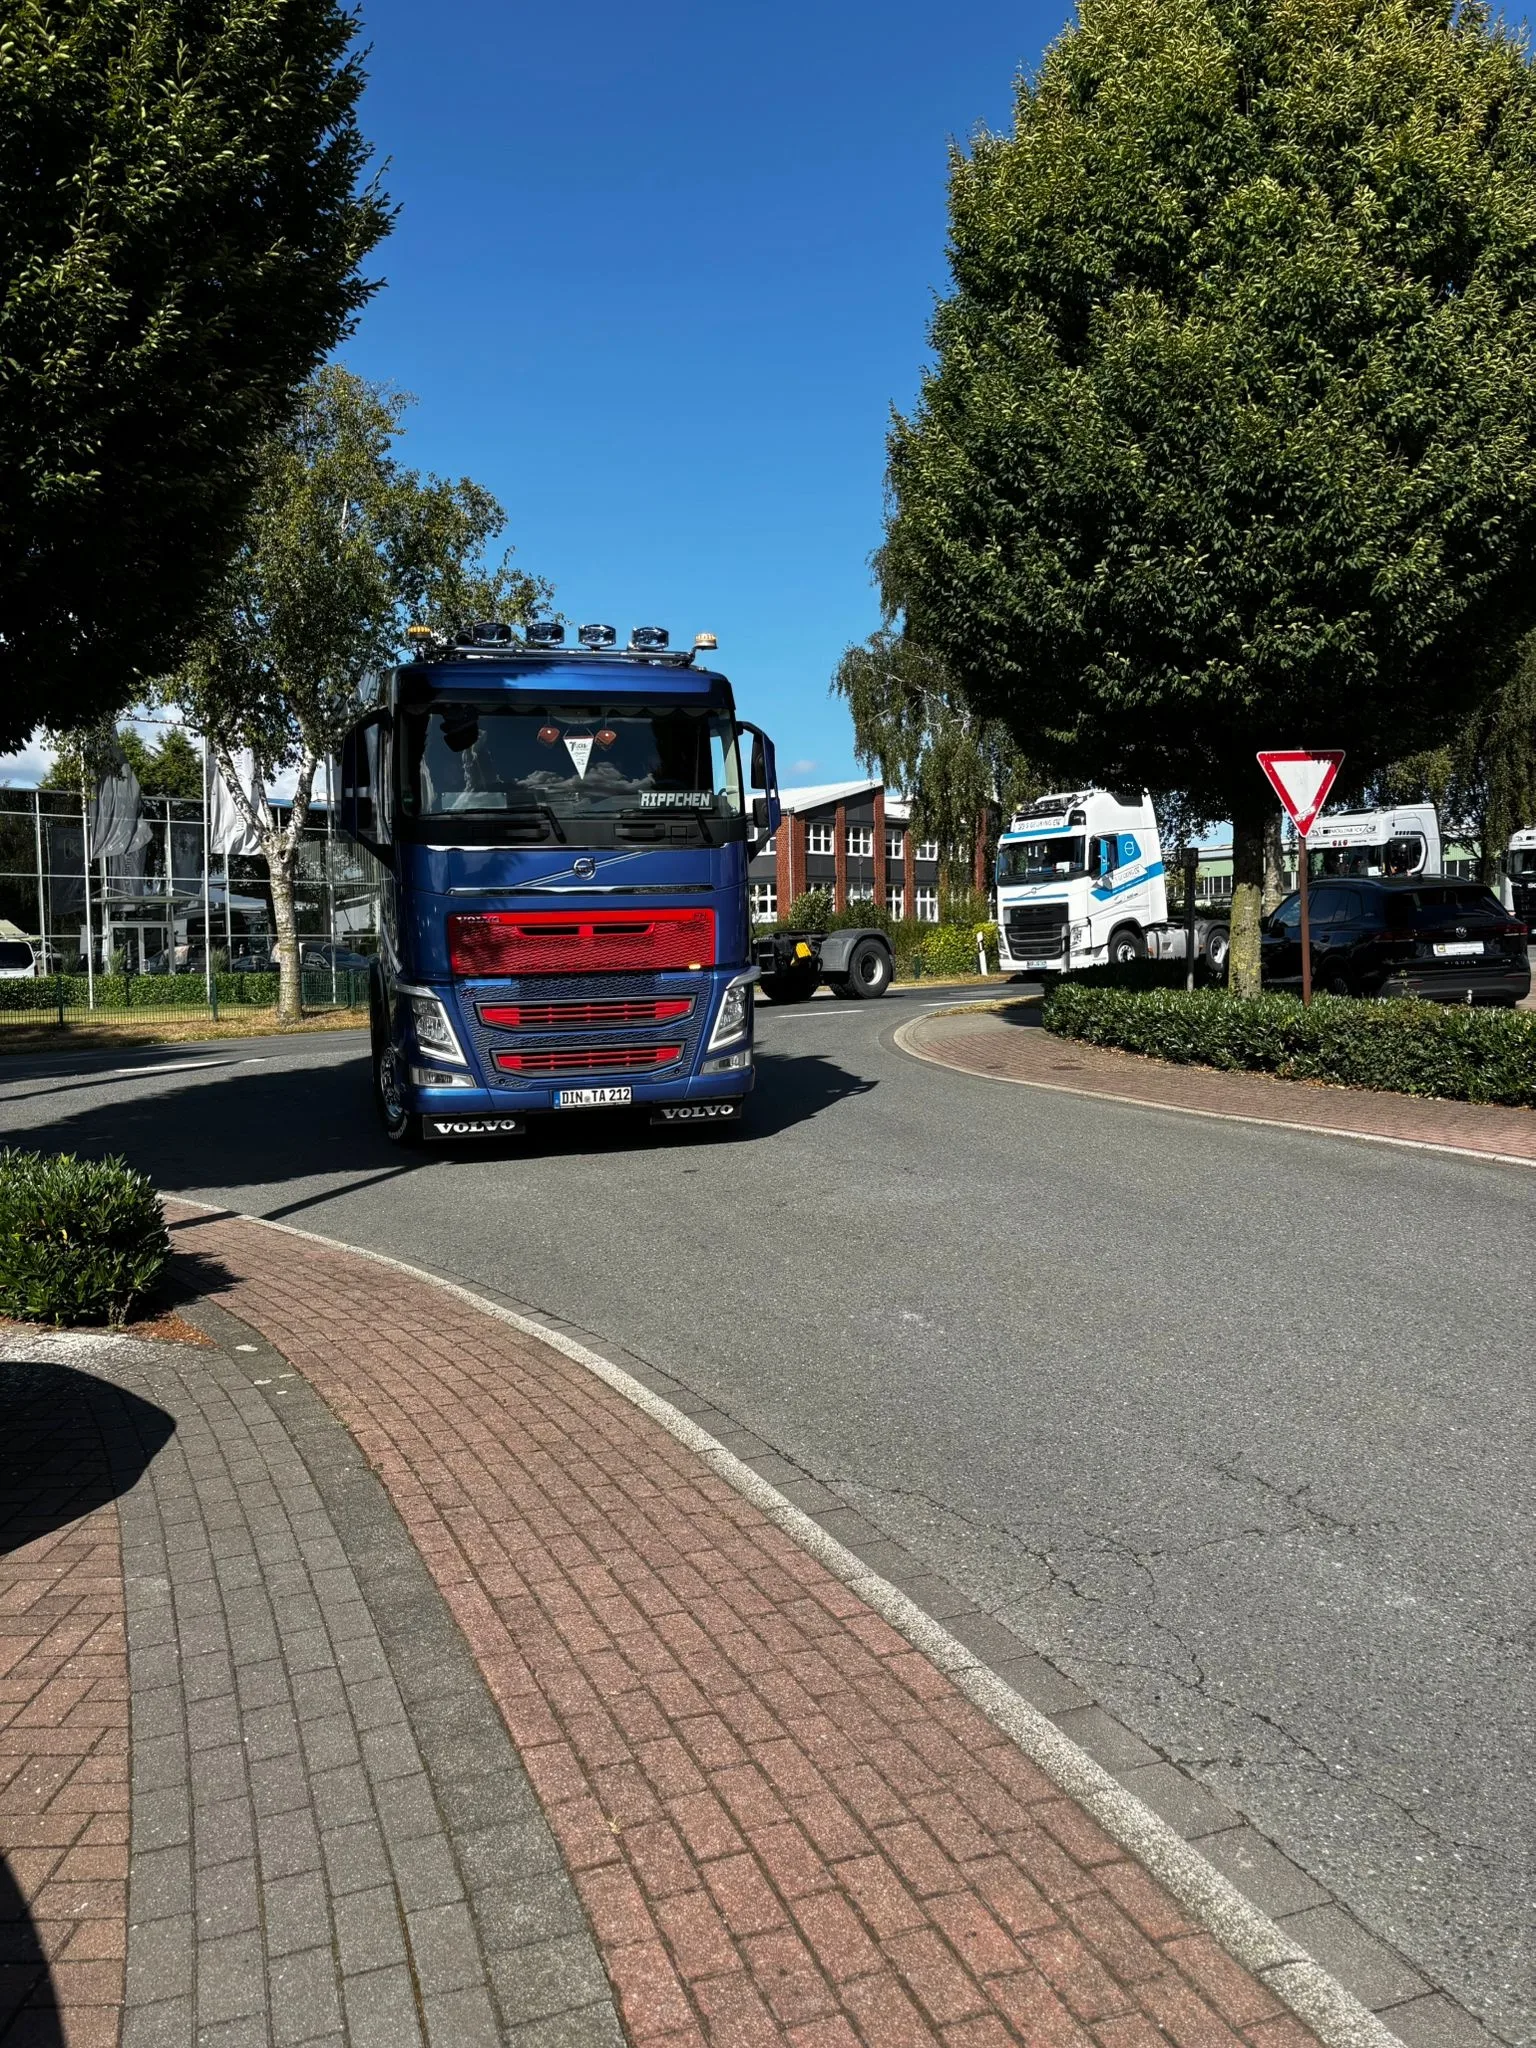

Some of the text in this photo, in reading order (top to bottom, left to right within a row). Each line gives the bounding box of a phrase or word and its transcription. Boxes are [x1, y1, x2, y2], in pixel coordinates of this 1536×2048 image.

[640, 792, 710, 807] RIPPCHEN
[561, 1088, 630, 1104] DIN TA 212
[661, 1104, 734, 1119] VOLVO
[434, 1119, 516, 1134] VOLVO
